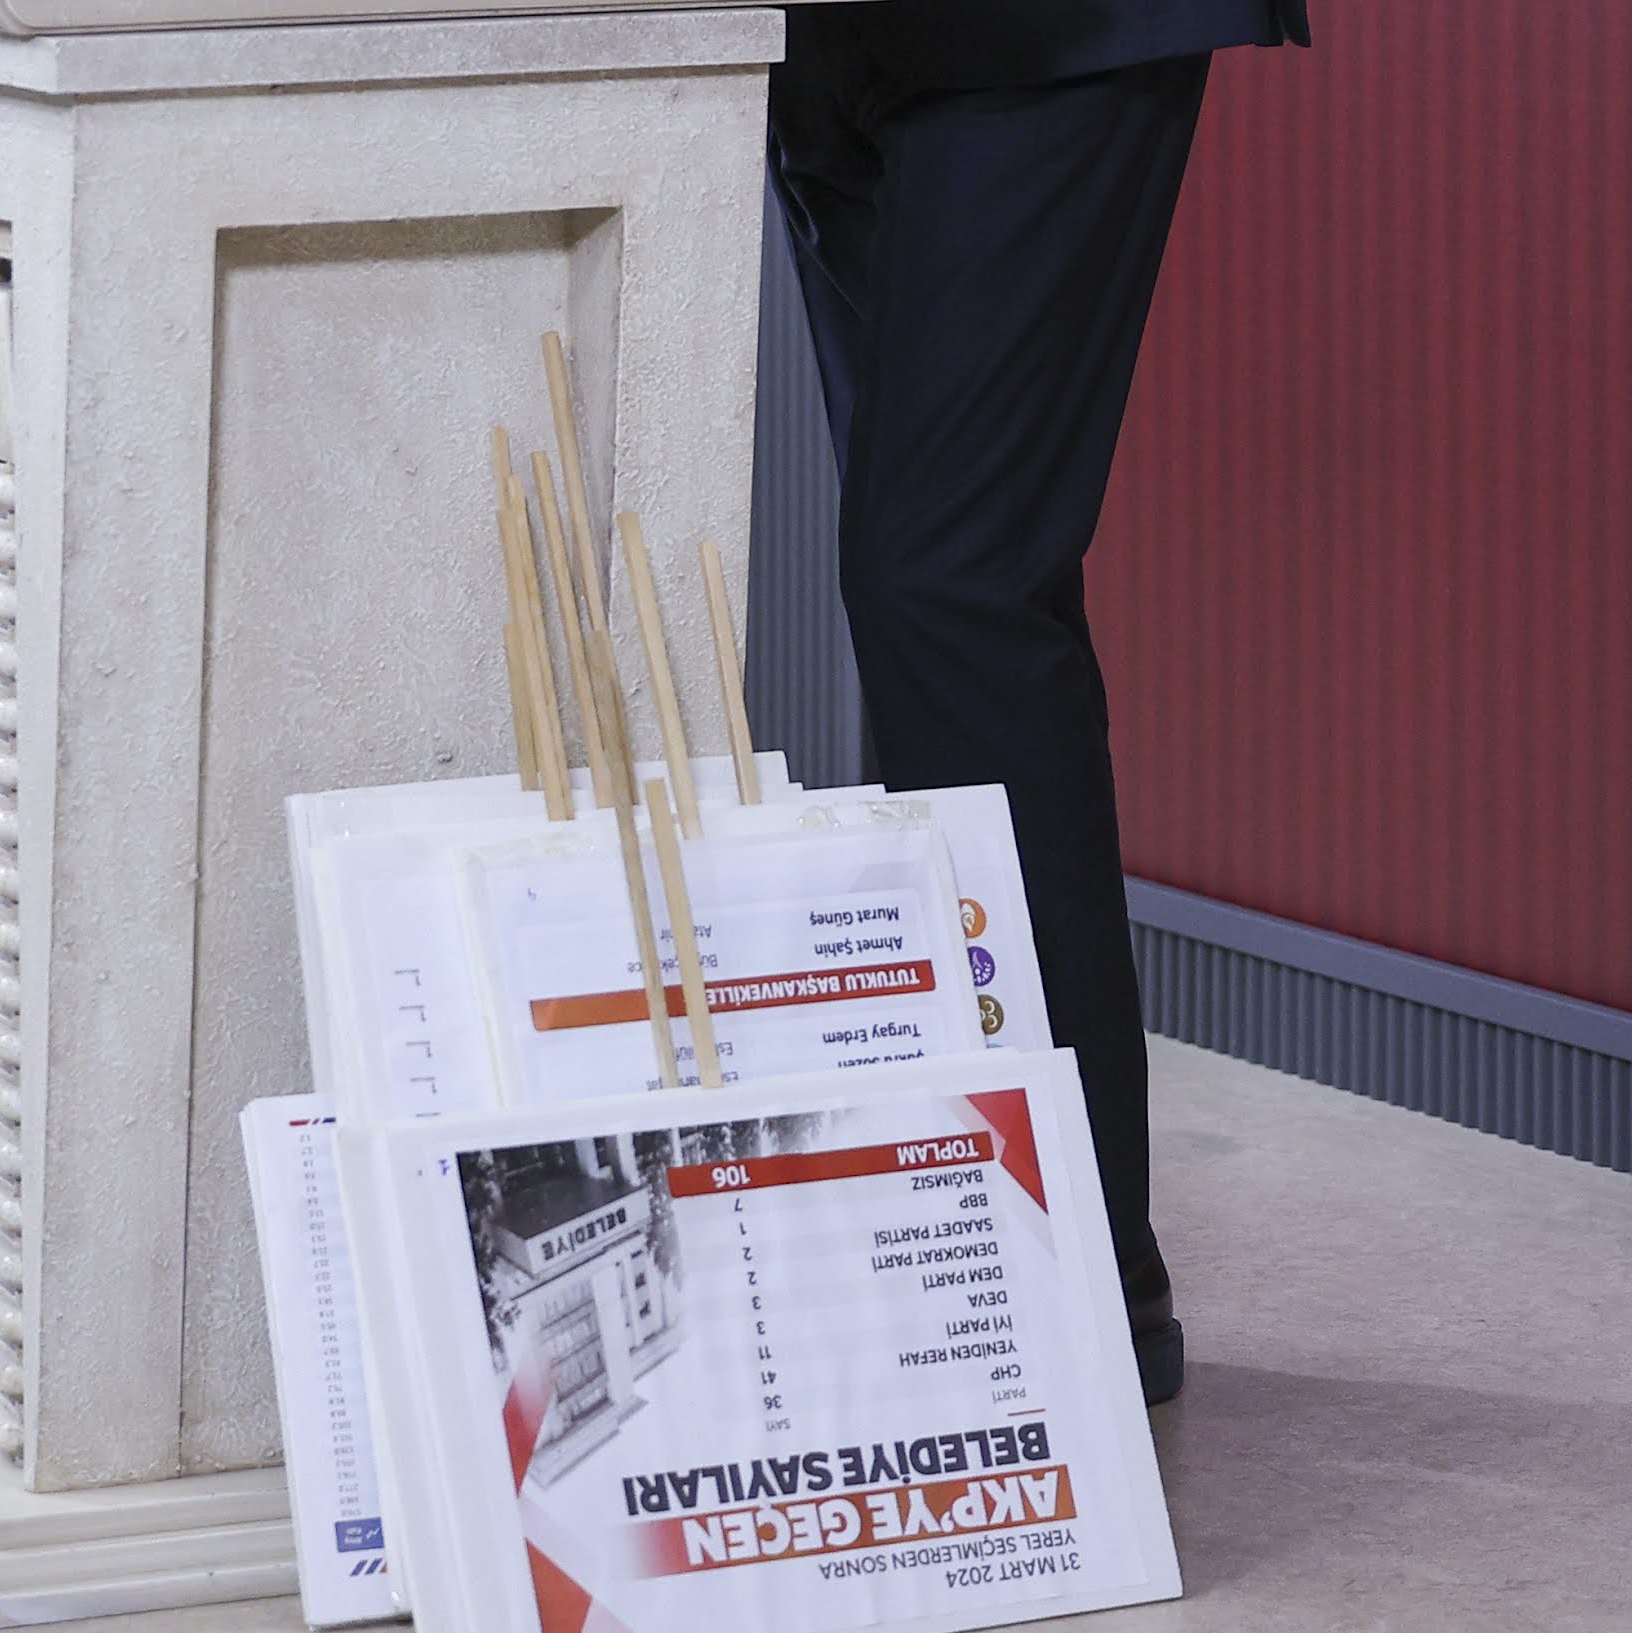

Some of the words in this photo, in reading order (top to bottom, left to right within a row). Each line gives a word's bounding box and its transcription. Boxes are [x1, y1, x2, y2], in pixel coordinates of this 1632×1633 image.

[809, 910, 853, 928] Güneş
[856, 906, 899, 924] Murat
[814, 938, 853, 958] Şahin
[856, 936, 903, 954] Ahmet
[705, 973, 841, 1006] BAŞKANVEKİLLE
[845, 968, 920, 991] TUTUKLU
[822, 1028, 867, 1045] Erdem
[871, 1022, 921, 1039] Turgay
[897, 1138, 979, 1166] TOPLAM
[711, 1164, 751, 1188] 106
[911, 1168, 983, 1190] BAĞIMSIZ
[735, 1198, 743, 1212] 7
[959, 1192, 988, 1209] BBP
[541, 1207, 627, 1261] BELEDİYE
[739, 1222, 747, 1236] 1
[873, 1225, 929, 1248] PARTİSİ
[933, 1217, 993, 1238] SAADET
[741, 1246, 752, 1261] 2
[871, 1252, 913, 1272] PARTİ
[915, 1241, 999, 1265] DEMOKRAT
[747, 1272, 757, 1286] 2
[922, 1270, 965, 1292] PARTİ
[969, 1266, 1003, 1283] DEM
[751, 1296, 761, 1310] 3
[967, 1290, 1007, 1308] DEVA
[756, 1320, 766, 1335] 3
[945, 1317, 990, 1340] PARTİ
[993, 1314, 1013, 1334] İYİ
[758, 1346, 771, 1360] 11
[899, 1348, 947, 1368] REFAH
[950, 1339, 1017, 1361] YENİDEN
[761, 1370, 776, 1385] 41
[991, 1364, 1021, 1380] CHP
[763, 1394, 782, 1410] 36
[837, 1422, 1050, 1486] BELEDİYE
[623, 1452, 833, 1516] SAYILARI
[865, 1470, 1059, 1541] AKP'YE
[681, 1497, 861, 1566] GEÇEN
[1020, 1528, 1076, 1550] YEREL
[891, 1534, 1016, 1570] SEÇİMLERDEN
[1059, 1552, 1080, 1570] 31
[818, 1554, 887, 1580] SONRA
[945, 1564, 993, 1588] 2024
[999, 1554, 1055, 1581] MART
